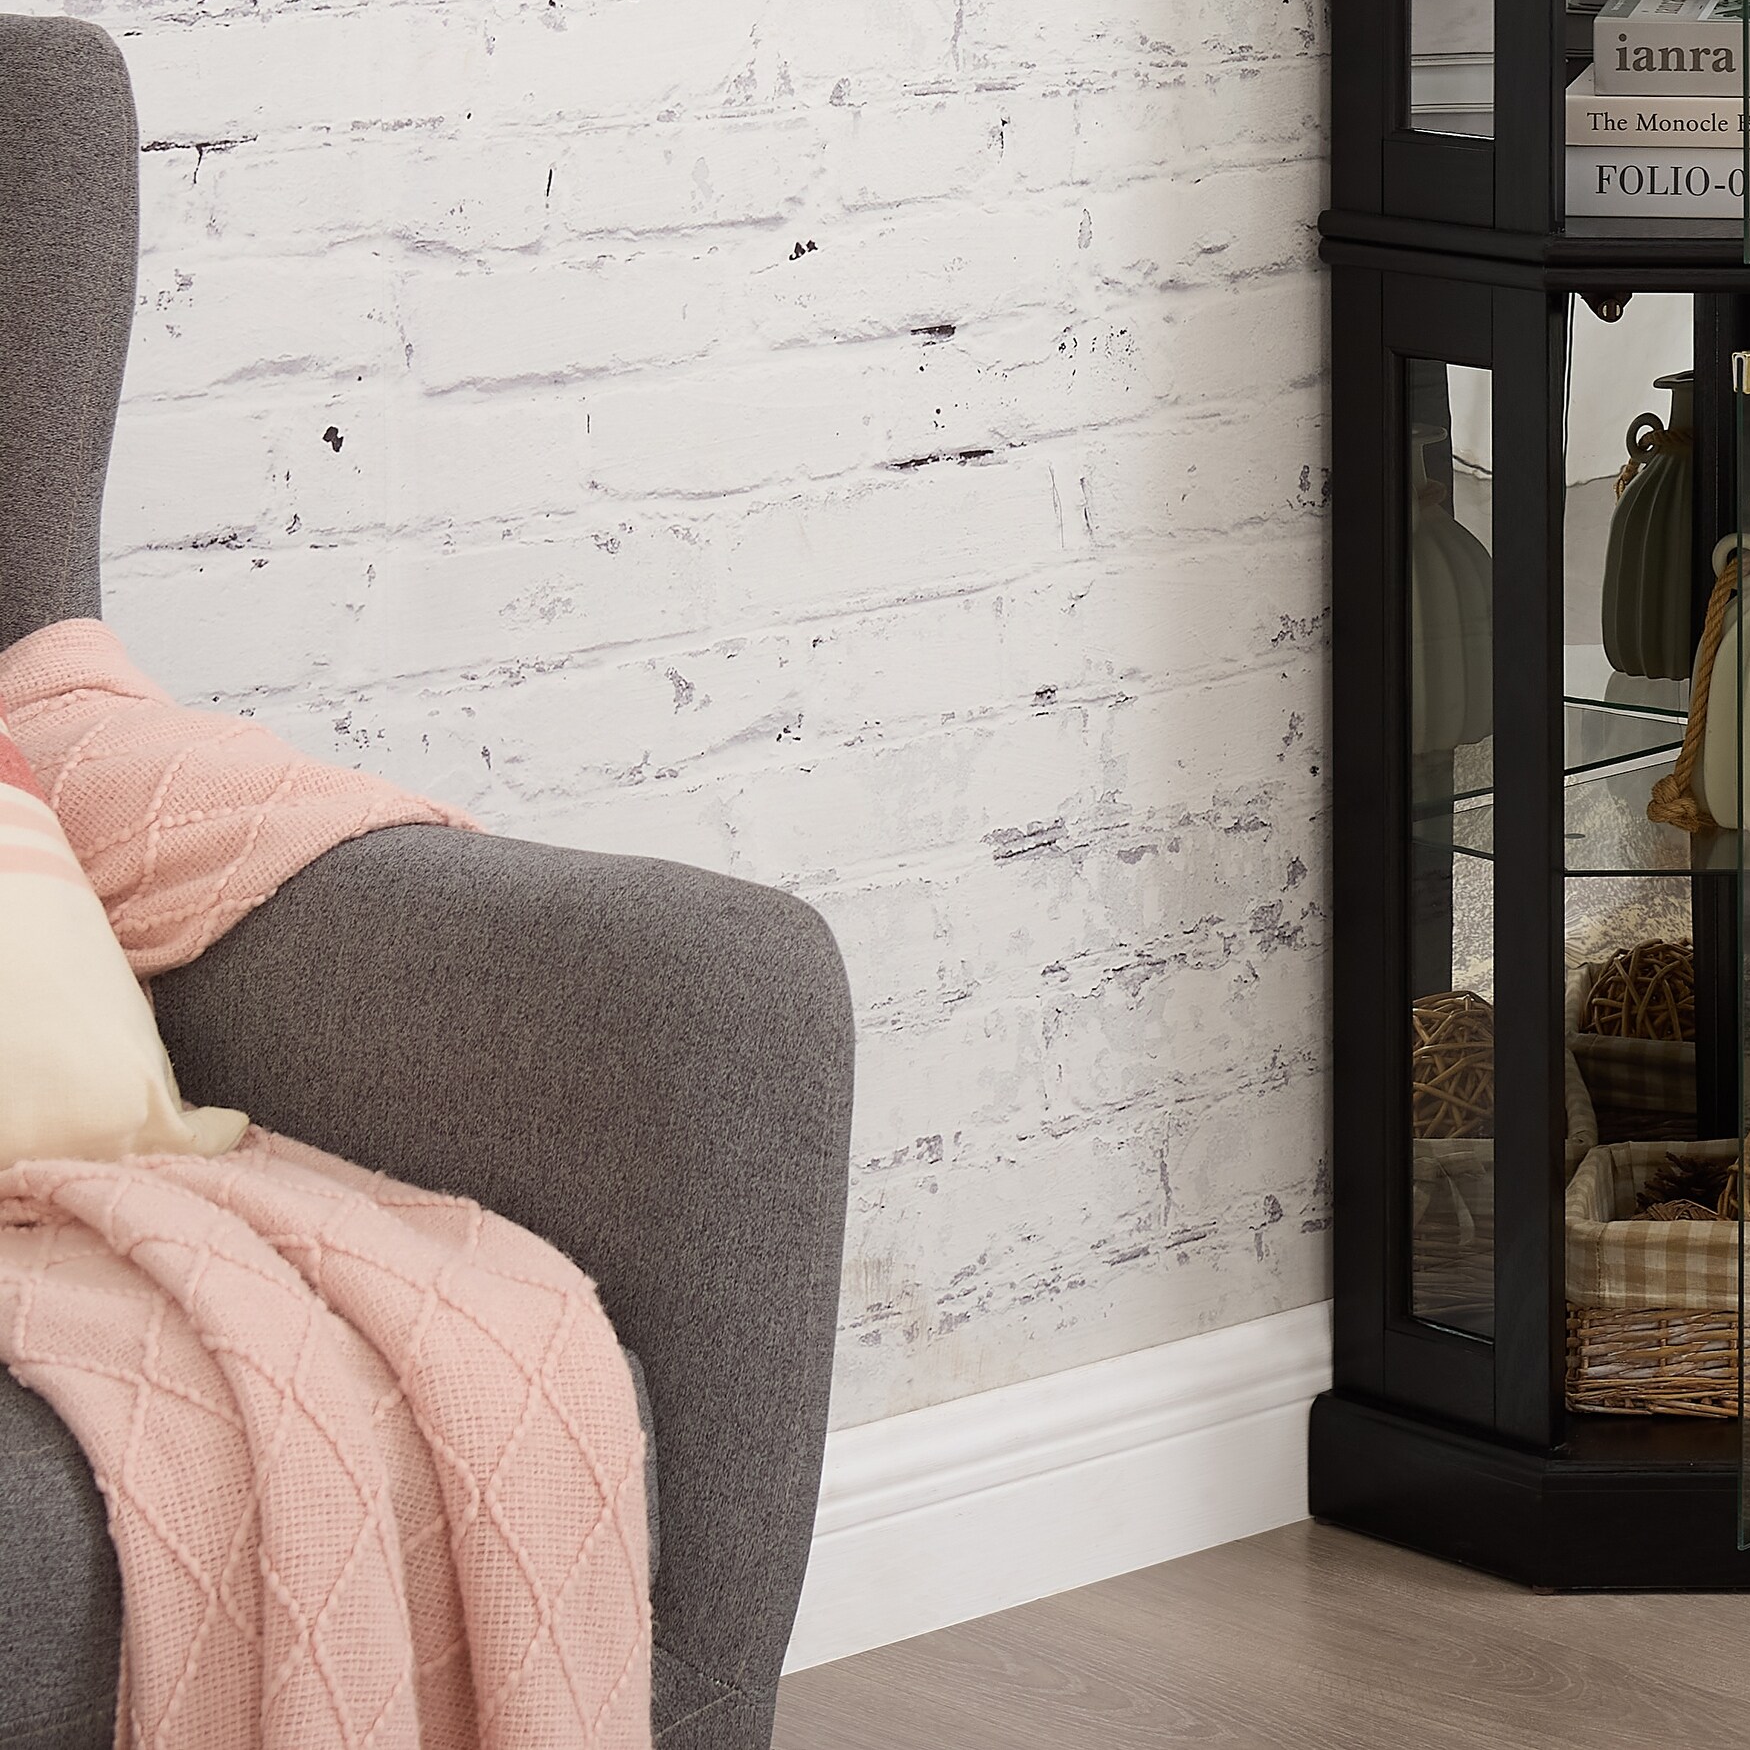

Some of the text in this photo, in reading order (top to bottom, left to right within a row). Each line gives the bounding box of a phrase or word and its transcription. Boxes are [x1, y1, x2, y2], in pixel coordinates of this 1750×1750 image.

[1615, 33, 1737, 73] ianra
[1587, 112, 1628, 132] The
[1635, 112, 1729, 132] Monocle
